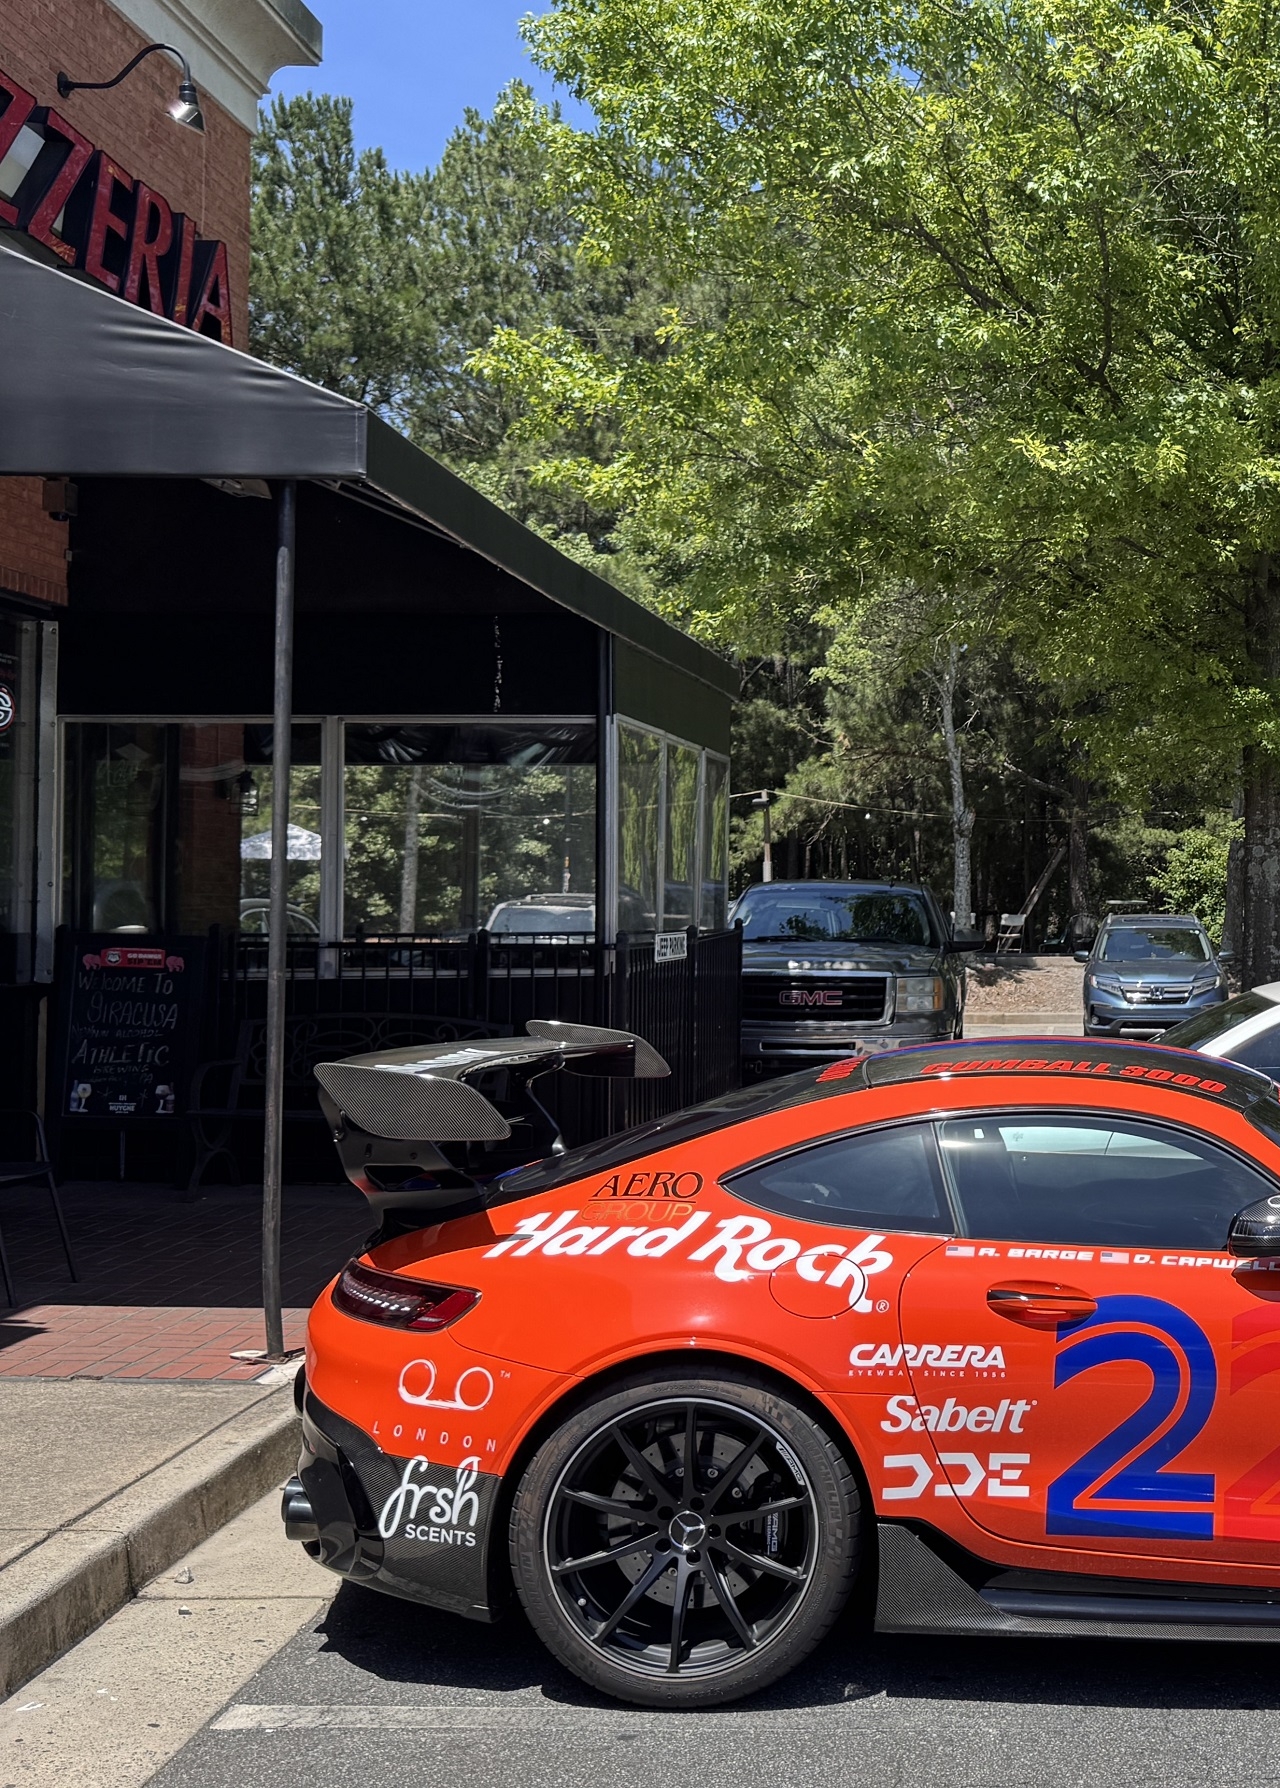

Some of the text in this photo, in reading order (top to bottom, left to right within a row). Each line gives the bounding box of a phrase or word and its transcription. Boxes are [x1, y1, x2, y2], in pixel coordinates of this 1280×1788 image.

[779, 990, 843, 1006] GMC
[920, 1058, 1228, 1094] GUMBALL 3000
[592, 1171, 704, 1200] AERO
[580, 1201, 693, 1222] GROUP
[482, 1208, 895, 1313] Hard Rock
[1007, 1247, 1094, 1261] BARGE
[1133, 1254, 1156, 1265] D.
[849, 1343, 1006, 1369] CARRERA
[848, 1369, 913, 1377] EYEWEAR
[880, 1395, 1032, 1434] Sabelt
[372, 1420, 497, 1452] LONDON
[378, 1454, 482, 1539] frsh
[404, 1523, 477, 1547] SCENTS
